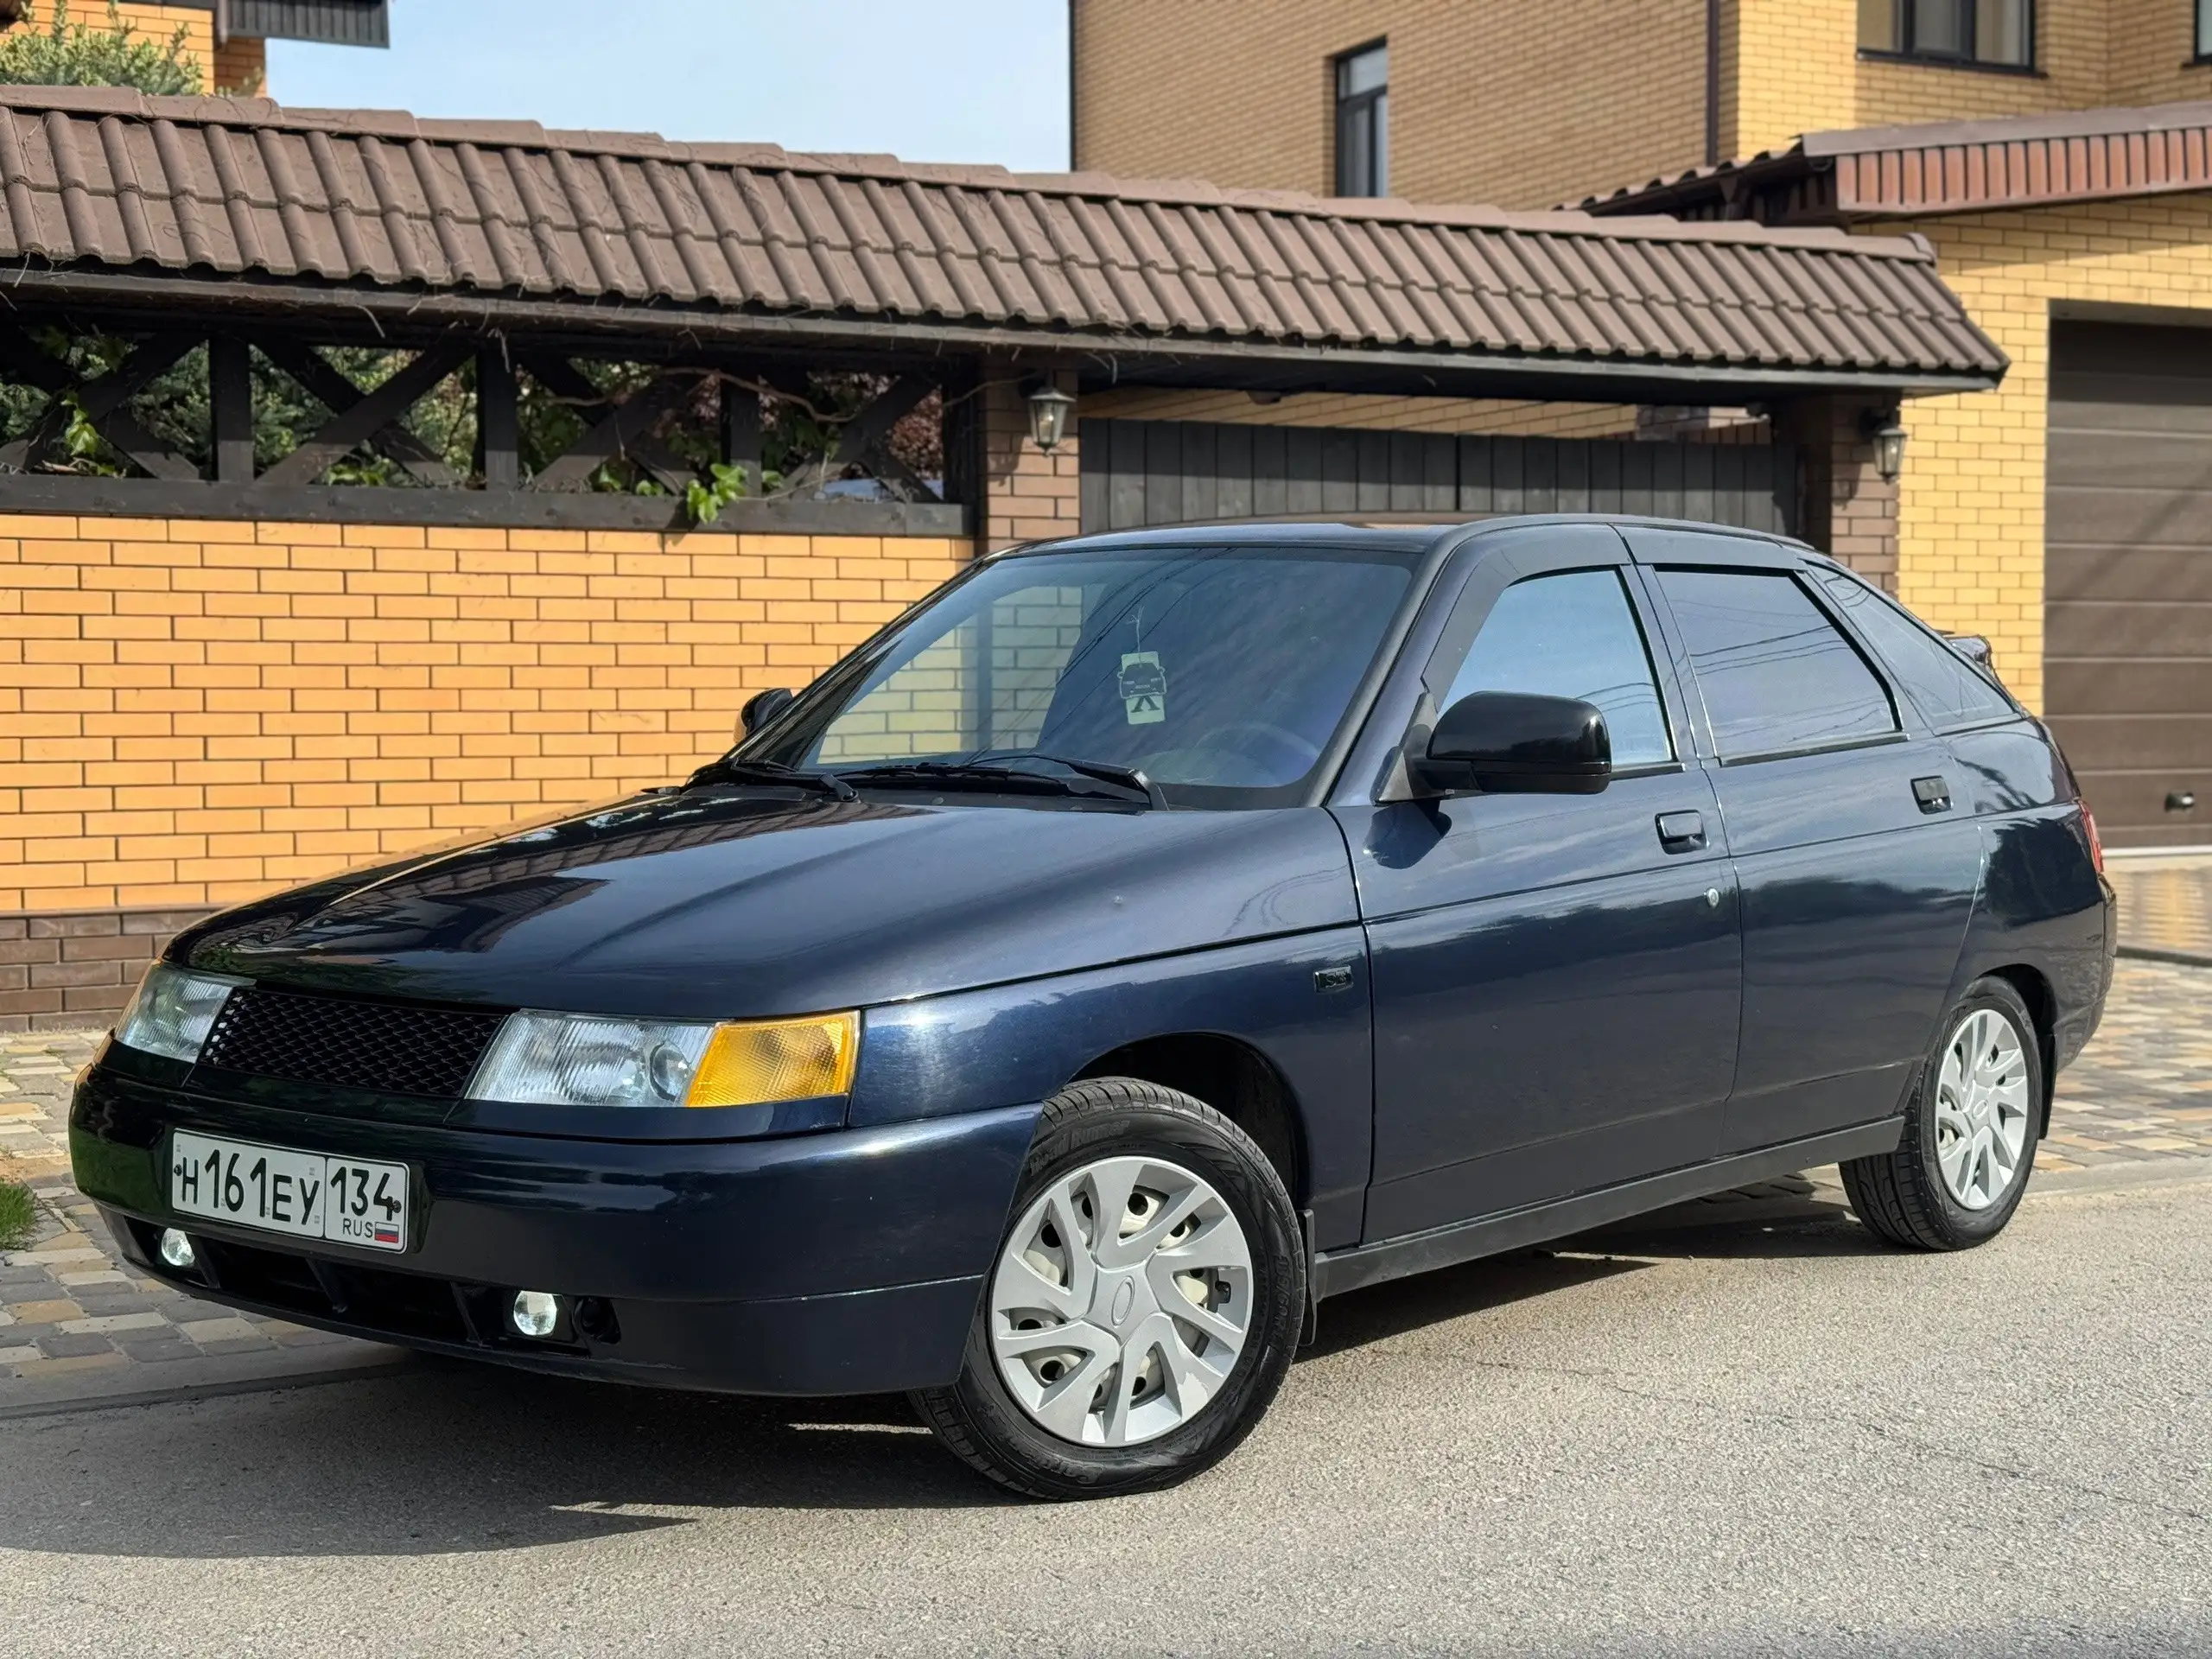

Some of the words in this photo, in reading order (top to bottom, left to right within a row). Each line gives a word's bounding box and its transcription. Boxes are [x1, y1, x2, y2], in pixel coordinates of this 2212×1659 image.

[182, 1149, 320, 1225] Н161ЕУ
[330, 1166, 394, 1221] 134
[342, 1217, 373, 1238] RUS
